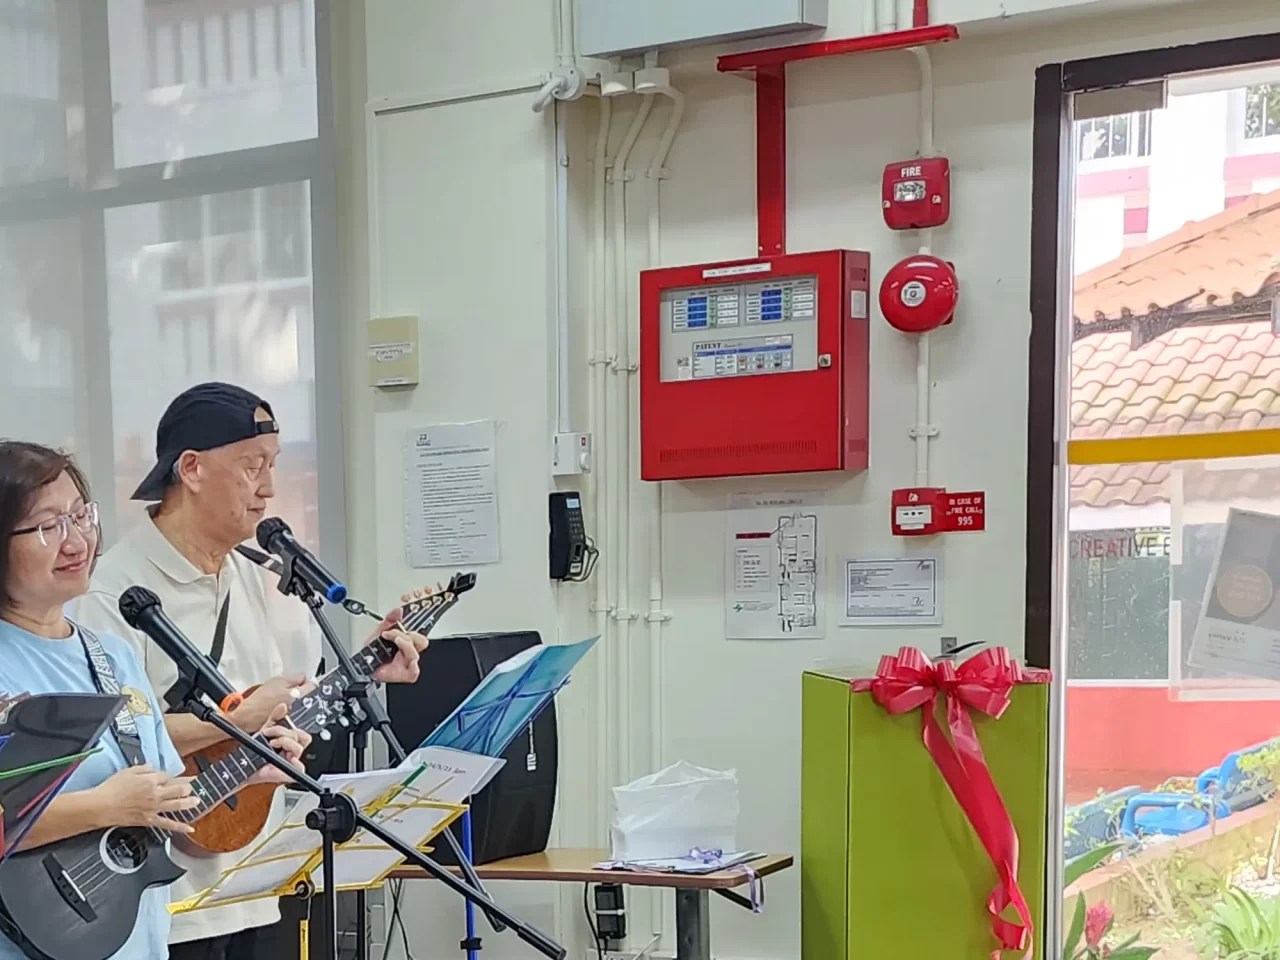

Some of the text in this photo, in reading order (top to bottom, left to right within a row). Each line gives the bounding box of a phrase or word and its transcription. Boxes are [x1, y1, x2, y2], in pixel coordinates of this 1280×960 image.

[901, 166, 921, 178] FIRE
[695, 342, 721, 350] PATENT
[957, 516, 973, 526] 995
